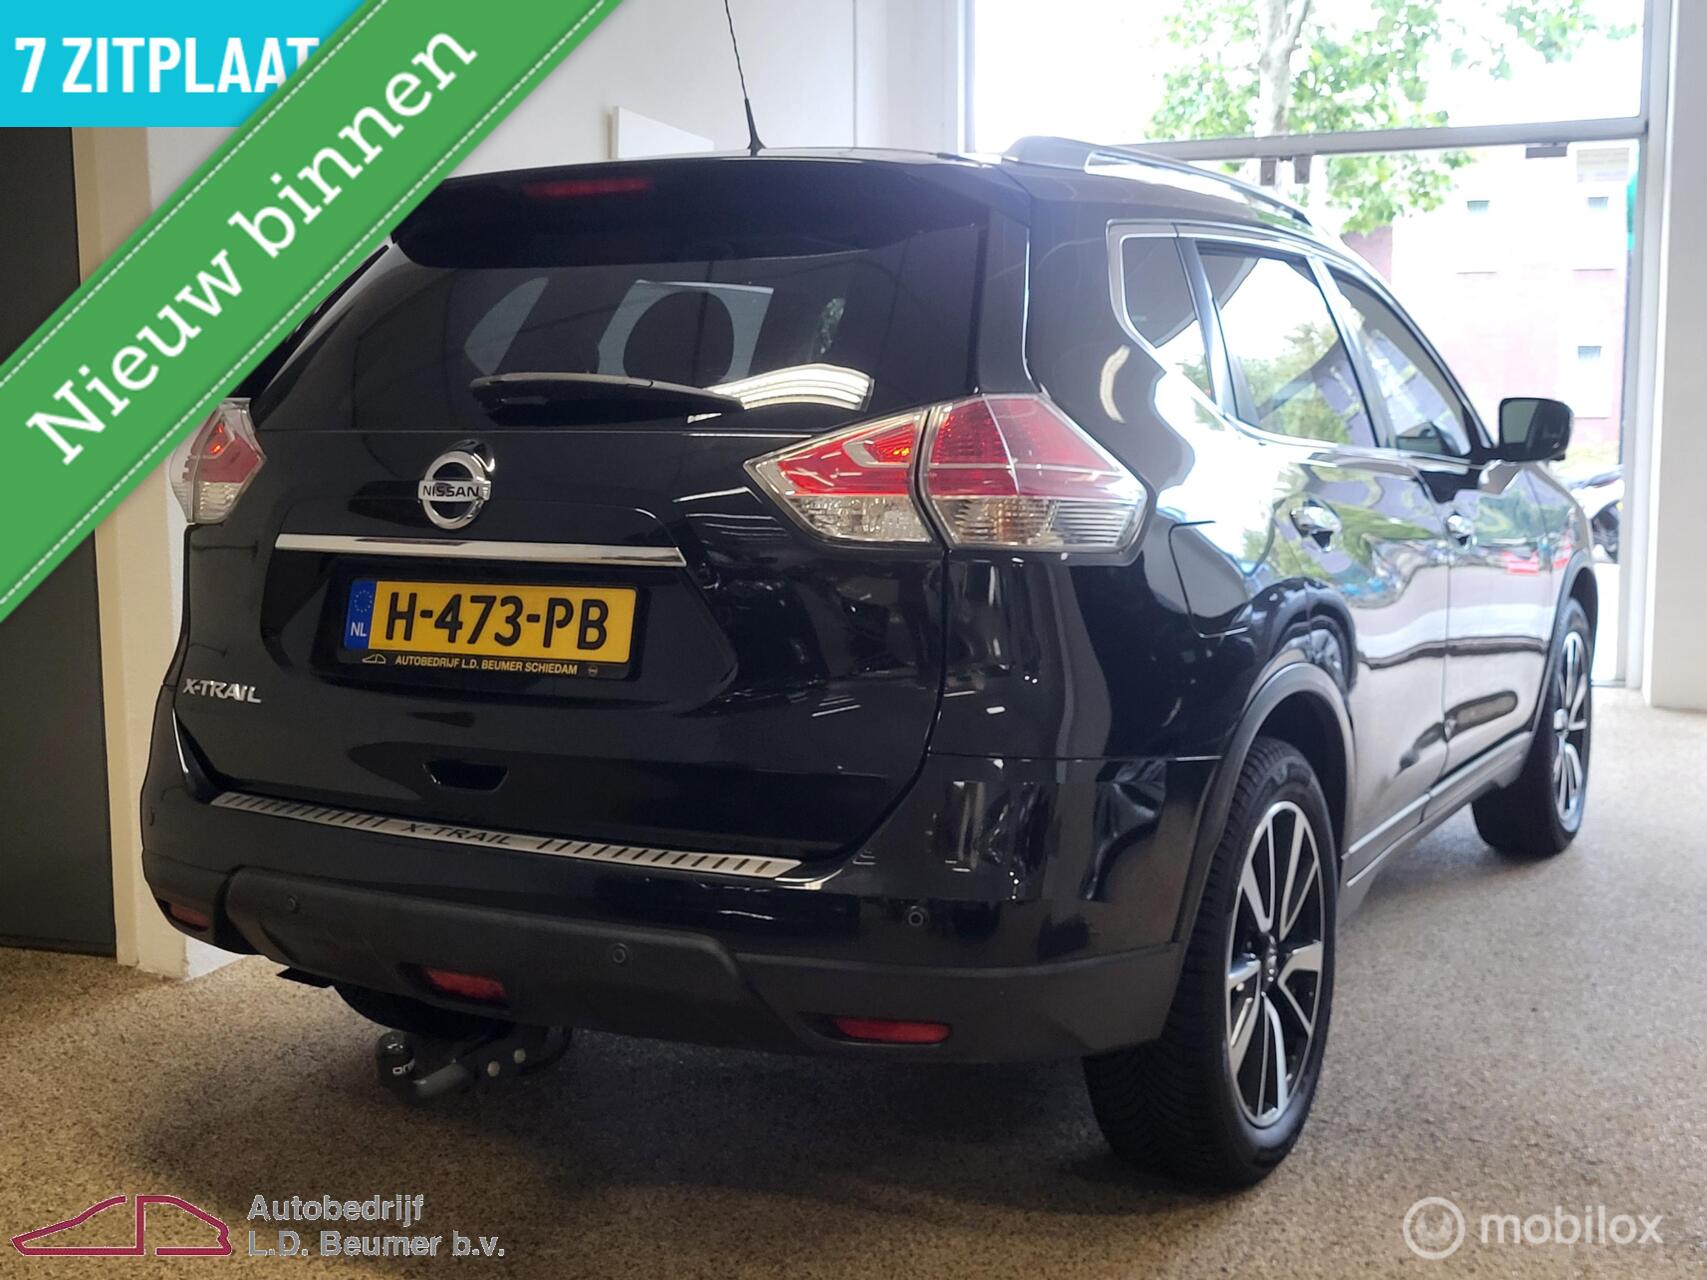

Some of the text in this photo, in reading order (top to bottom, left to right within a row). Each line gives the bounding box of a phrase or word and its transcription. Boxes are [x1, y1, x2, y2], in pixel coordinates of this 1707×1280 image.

[422, 484, 480, 498] NISSAN
[350, 621, 368, 637] NL
[385, 591, 609, 651] H-473-PB
[395, 655, 578, 675] AUTOBEDRIJF L.D. BEUMER SCHIEDAM
[182, 678, 262, 703] X-TRAIL
[400, 823, 511, 845] X-TRAIL
